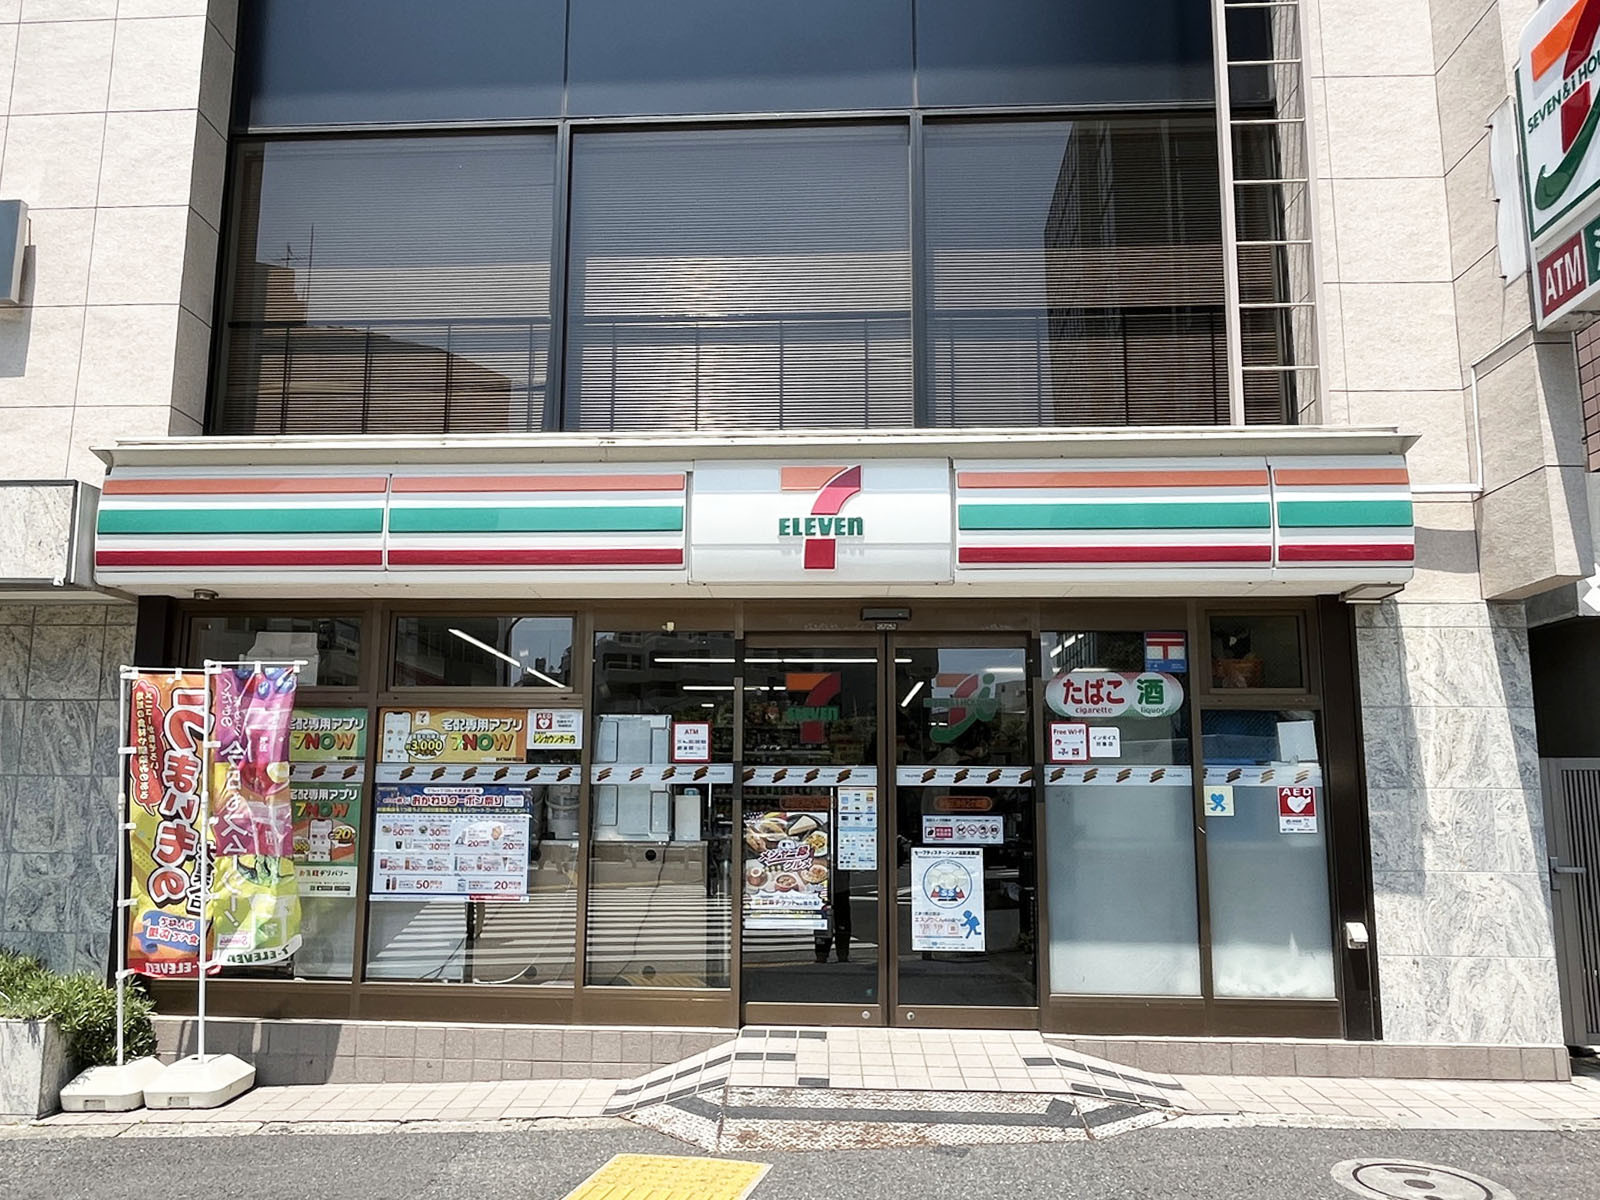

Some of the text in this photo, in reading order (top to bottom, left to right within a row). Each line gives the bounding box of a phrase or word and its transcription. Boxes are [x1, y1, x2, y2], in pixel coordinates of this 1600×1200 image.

[1545, 242, 1583, 306] ATM
[1063, 679, 1165, 705] たばこ 酒
[1075, 706, 1113, 715] cigarette
[442, 718, 524, 732] 宅配専用アプリ
[1281, 788, 1312, 796] AED
[416, 880, 430, 889] 50
[494, 881, 508, 890] 20
